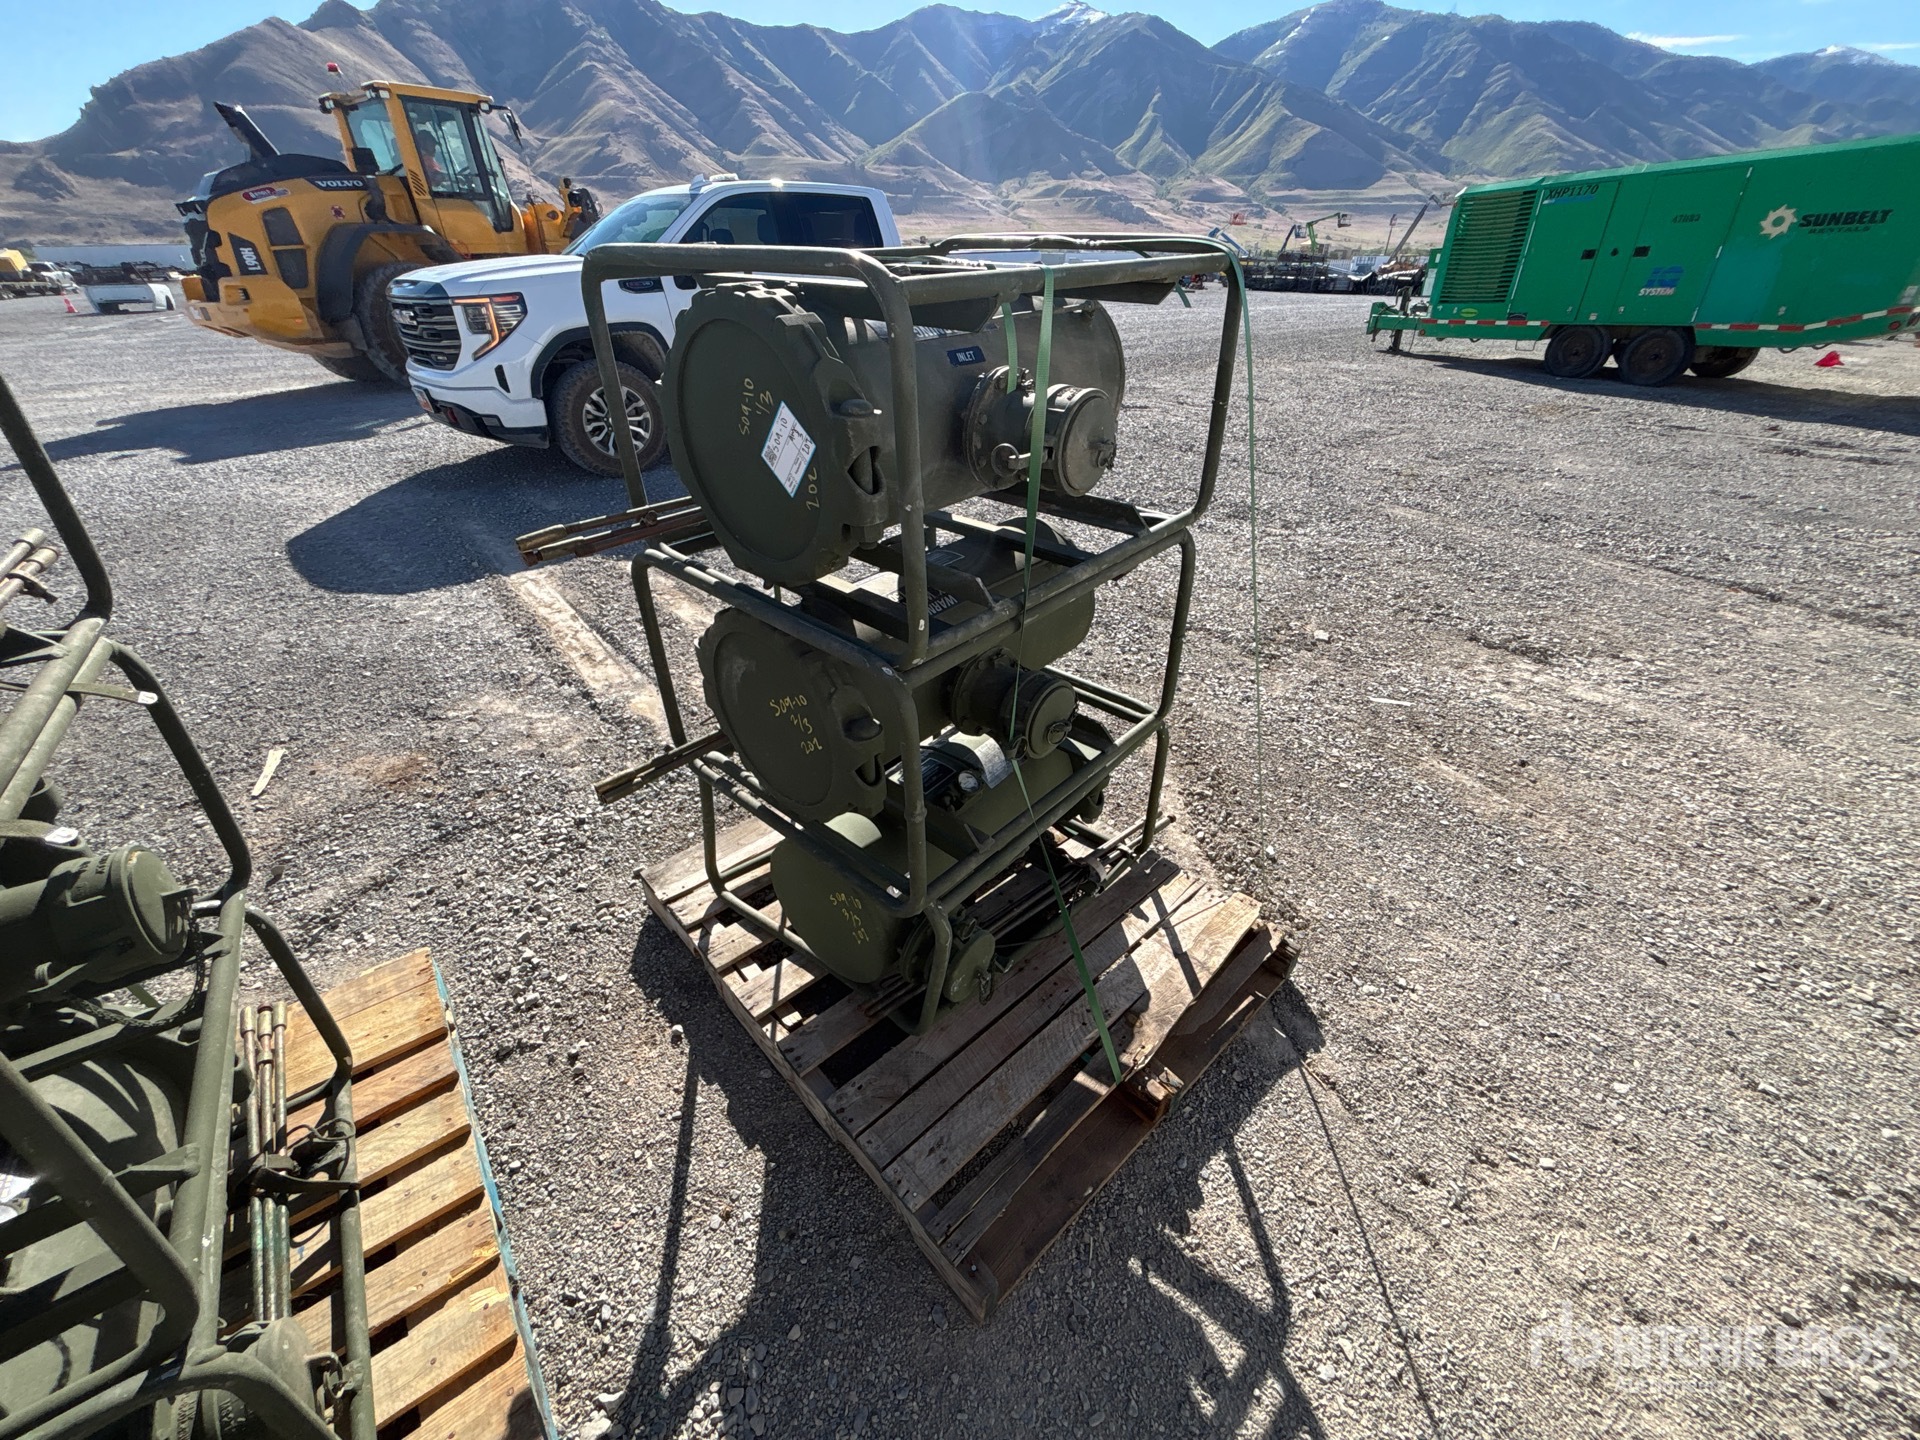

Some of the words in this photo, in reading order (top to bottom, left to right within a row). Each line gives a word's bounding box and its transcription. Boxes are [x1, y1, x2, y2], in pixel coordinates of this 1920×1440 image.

[1546, 184, 1600, 200] XHP1170
[1799, 209, 1894, 228] SUNBELT
[239, 247, 262, 271] L90H
[1638, 287, 1677, 297] SYSTEM
[956, 350, 976, 363] INLET
[790, 713, 813, 735] 2/3
[800, 737, 823, 755] 202
[841, 908, 862, 928] 3/3
